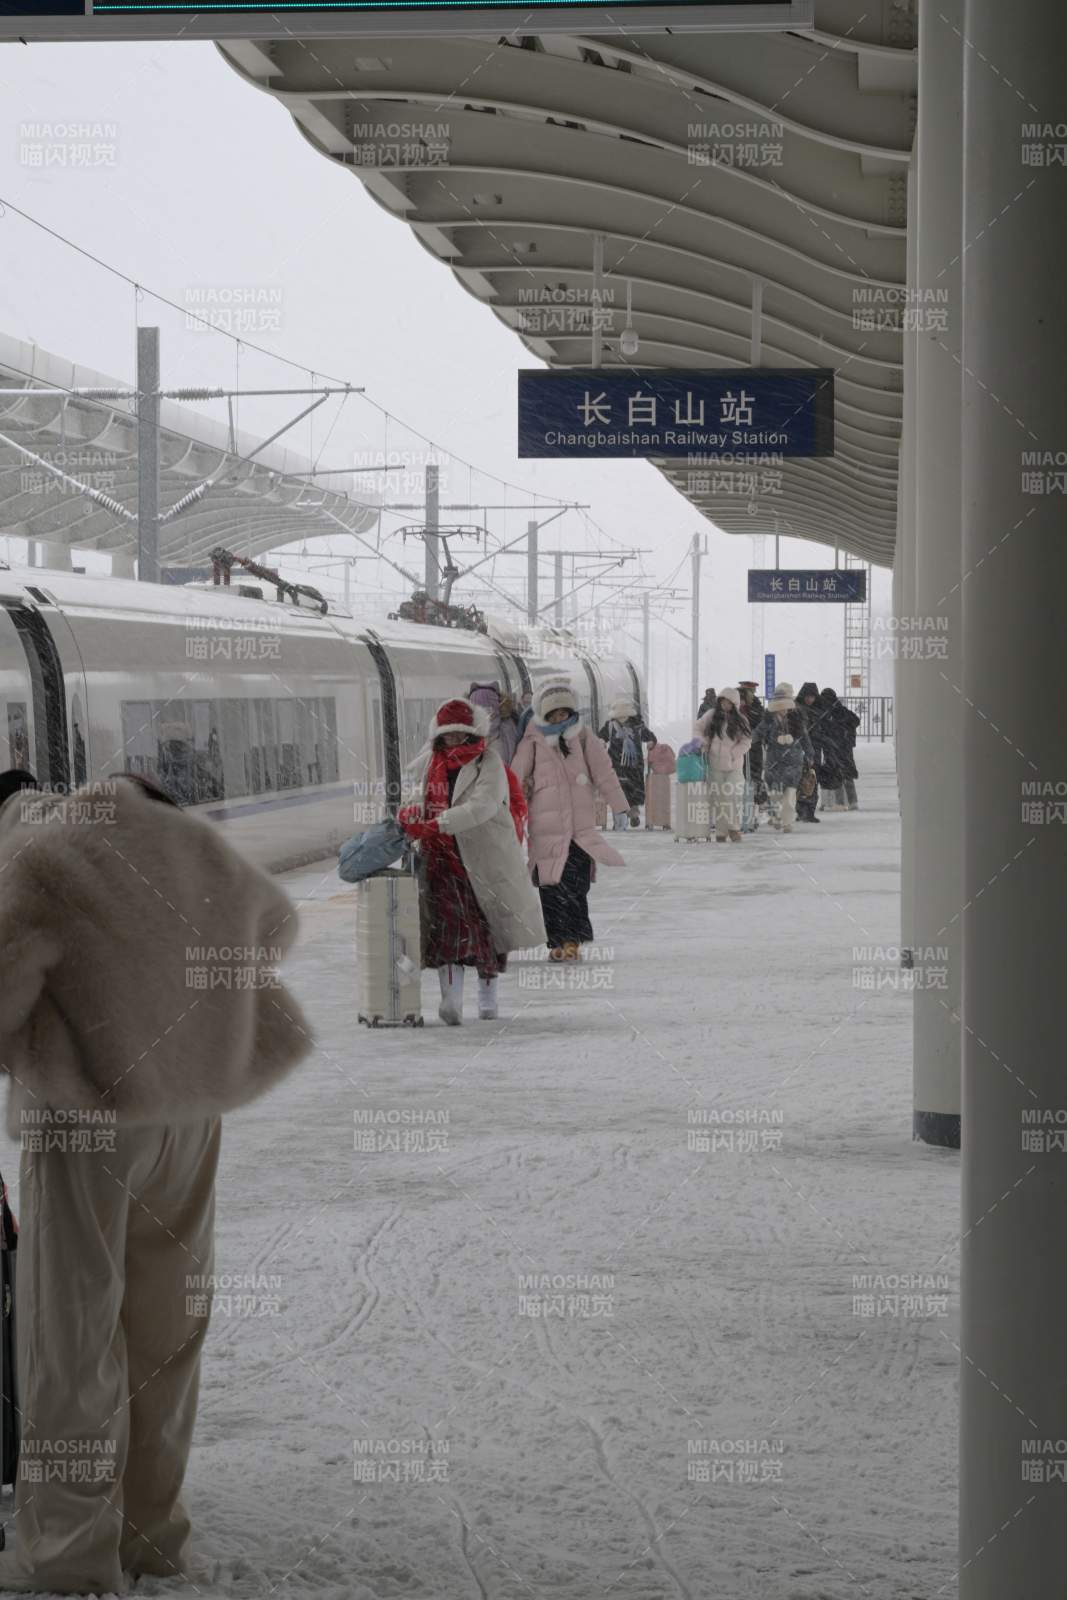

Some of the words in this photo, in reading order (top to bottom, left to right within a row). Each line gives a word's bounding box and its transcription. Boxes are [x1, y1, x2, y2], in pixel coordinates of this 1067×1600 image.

[577, 391, 756, 427] 长白山站
[544, 431, 660, 448] Changbaishan
[664, 431, 727, 446] Railway
[731, 431, 788, 445] Station
[769, 577, 837, 592] 长白山站
